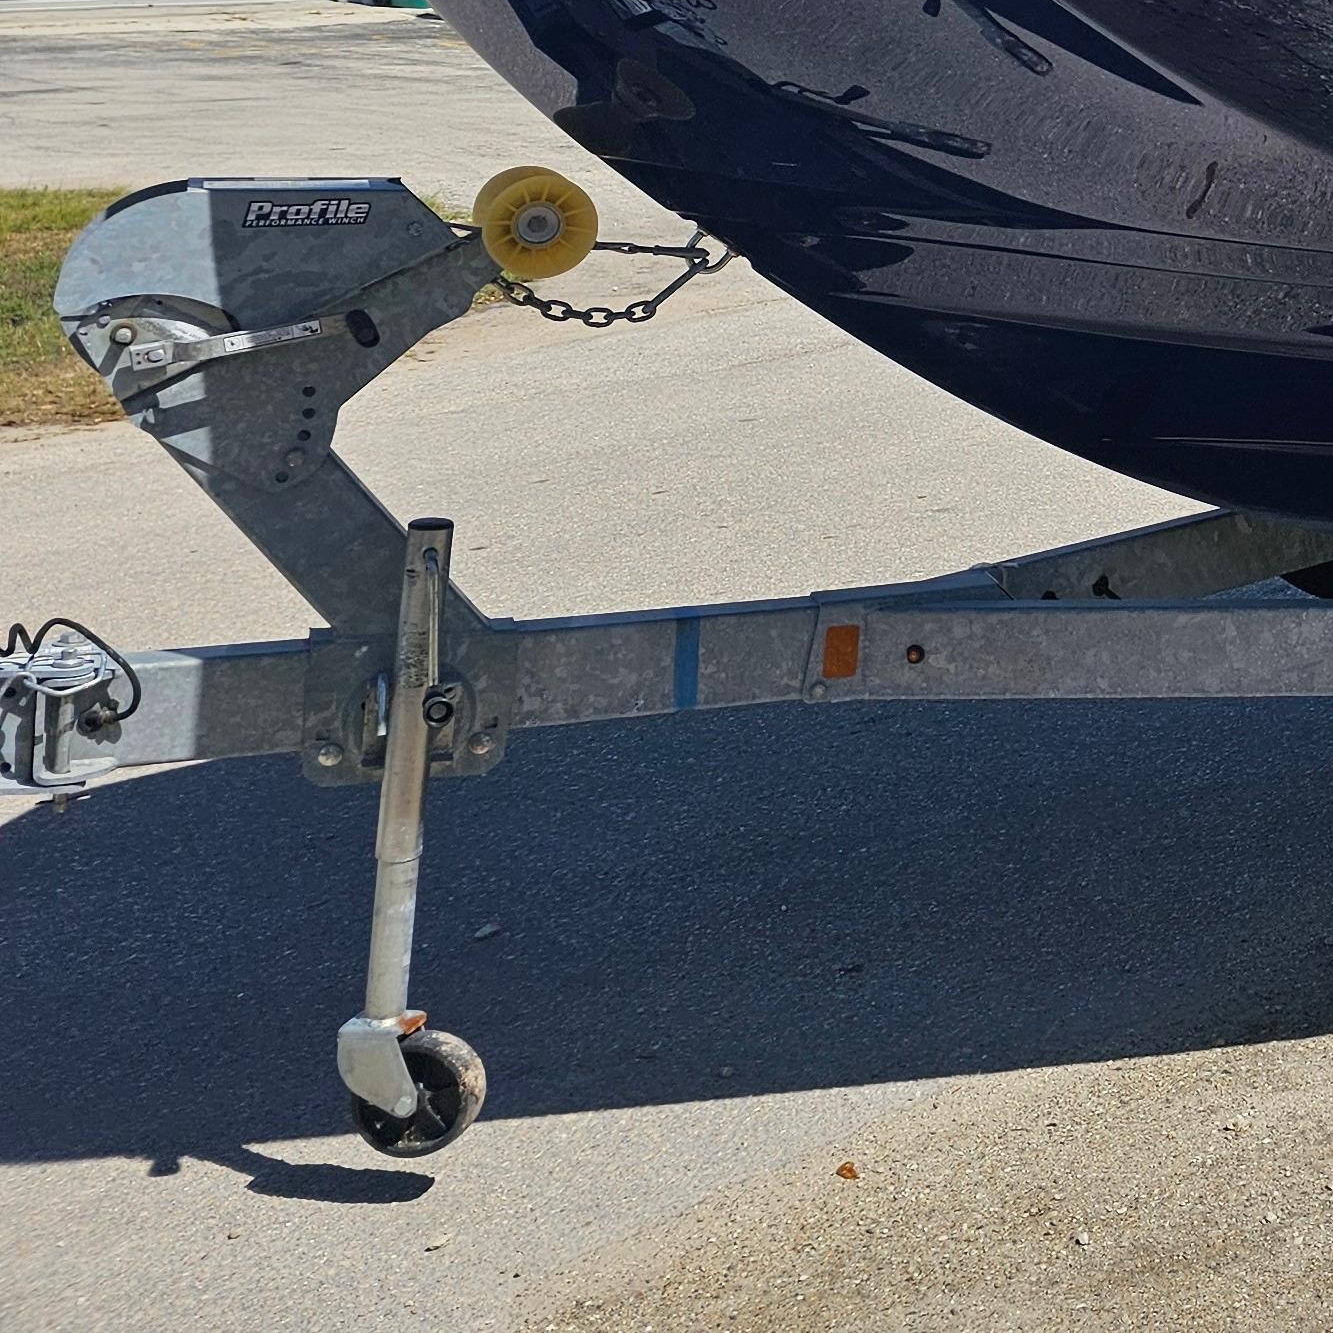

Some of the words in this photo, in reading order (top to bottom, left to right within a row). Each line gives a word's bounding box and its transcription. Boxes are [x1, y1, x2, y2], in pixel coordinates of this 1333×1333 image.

[246, 199, 370, 221] Profile
[245, 217, 324, 227] PERFORMANCE
[328, 217, 365, 225] WINCH
